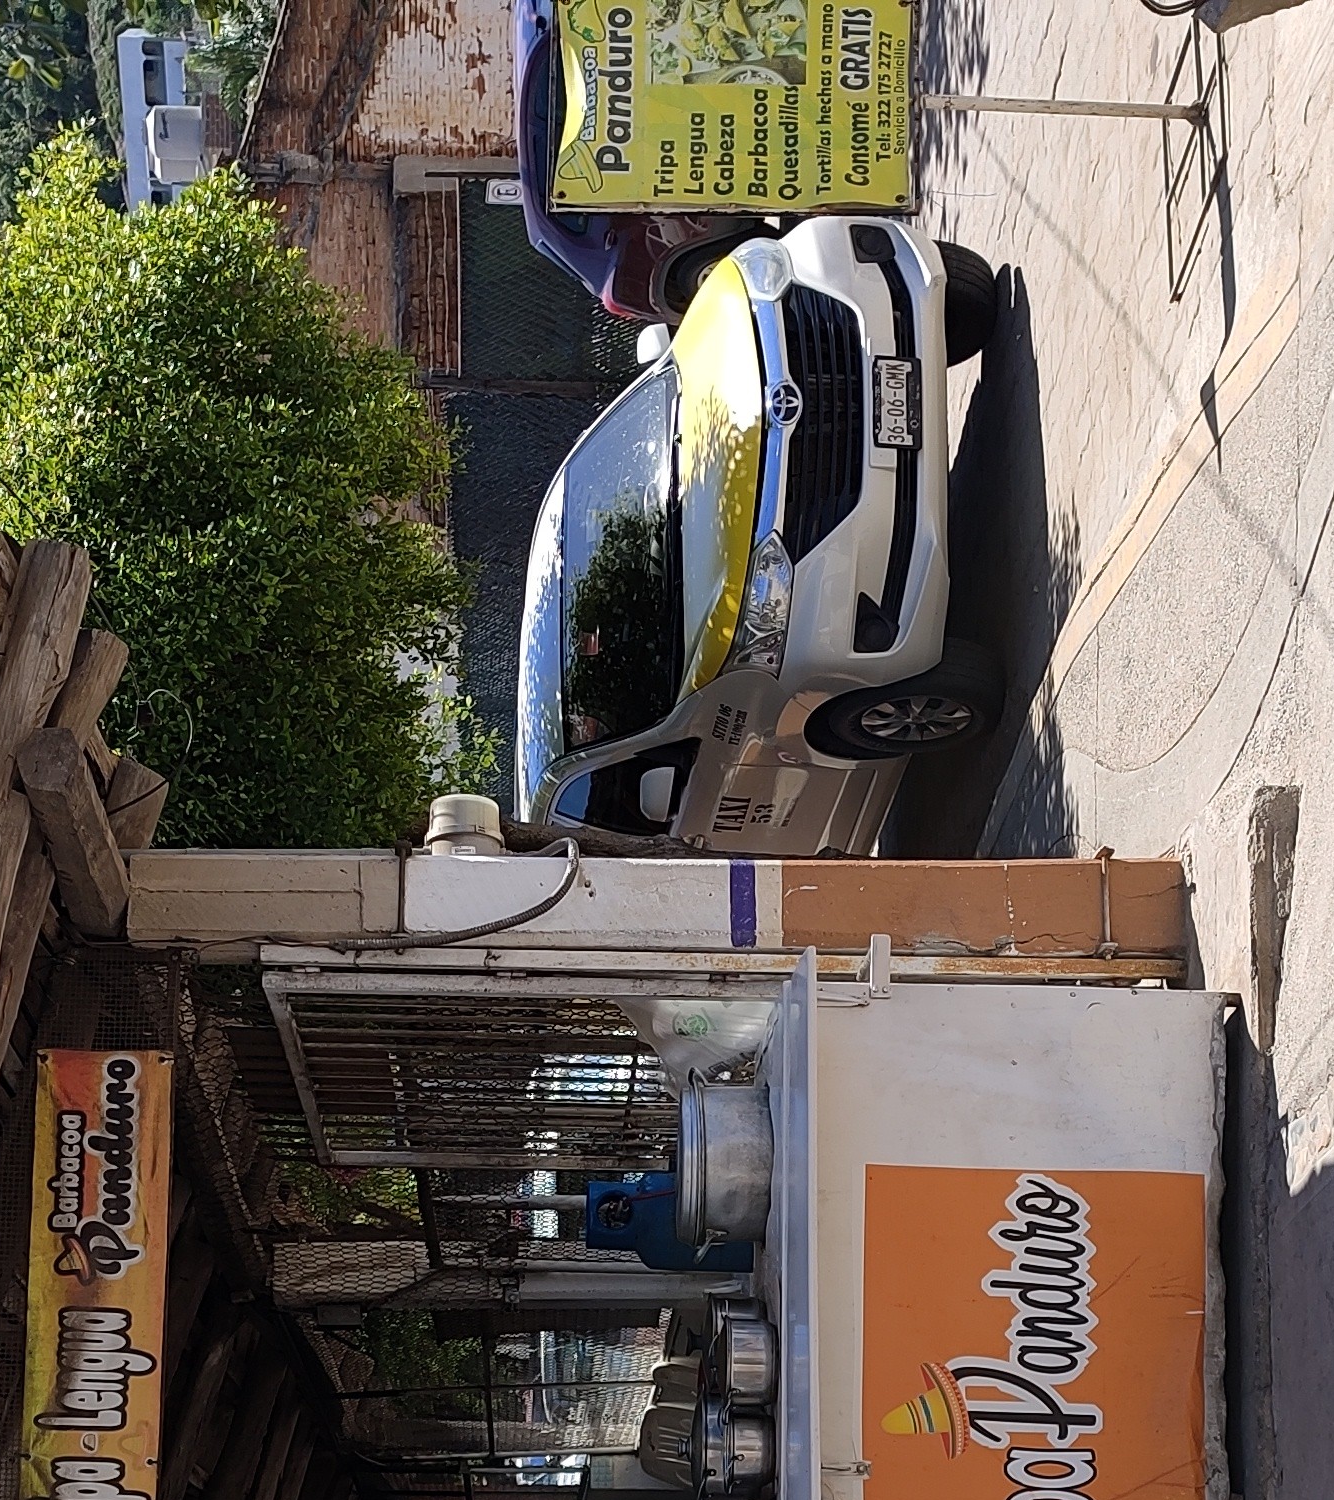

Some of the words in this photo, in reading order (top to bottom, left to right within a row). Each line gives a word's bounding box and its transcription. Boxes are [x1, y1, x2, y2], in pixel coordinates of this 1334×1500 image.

[820, 3, 834, 50] mano
[839, 8, 873, 91] GRATIS
[878, 30, 893, 70] 2727
[822, 55, 832, 65] a
[878, 74, 892, 96] 175
[893, 39, 906, 94] Domicilio
[596, 7, 633, 173] Panduro
[816, 70, 832, 125] hechas
[878, 100, 891, 129] 322
[684, 112, 707, 195] Lengua
[713, 114, 734, 196] Cabeza
[747, 88, 768, 198] Barbacoa
[778, 86, 802, 200] Quesadillas
[844, 101, 870, 186] Consomé
[876, 133, 891, 162] Tel:
[893, 106, 906, 155] Servicio
[653, 140, 678, 197] Tripa
[816, 130, 832, 195] Tortillas
[885, 363, 905, 443] 36-06-GMK
[712, 715, 730, 741] SITIO
[718, 703, 733, 717] 06
[712, 795, 752, 833] TAXI
[750, 803, 776, 824] 53
[47, 1110, 86, 1233] Barbacoa
[75, 1058, 140, 1276] Panduro
[951, 1178, 1097, 1445] Panduro
[33, 1306, 156, 1432] Lengua
